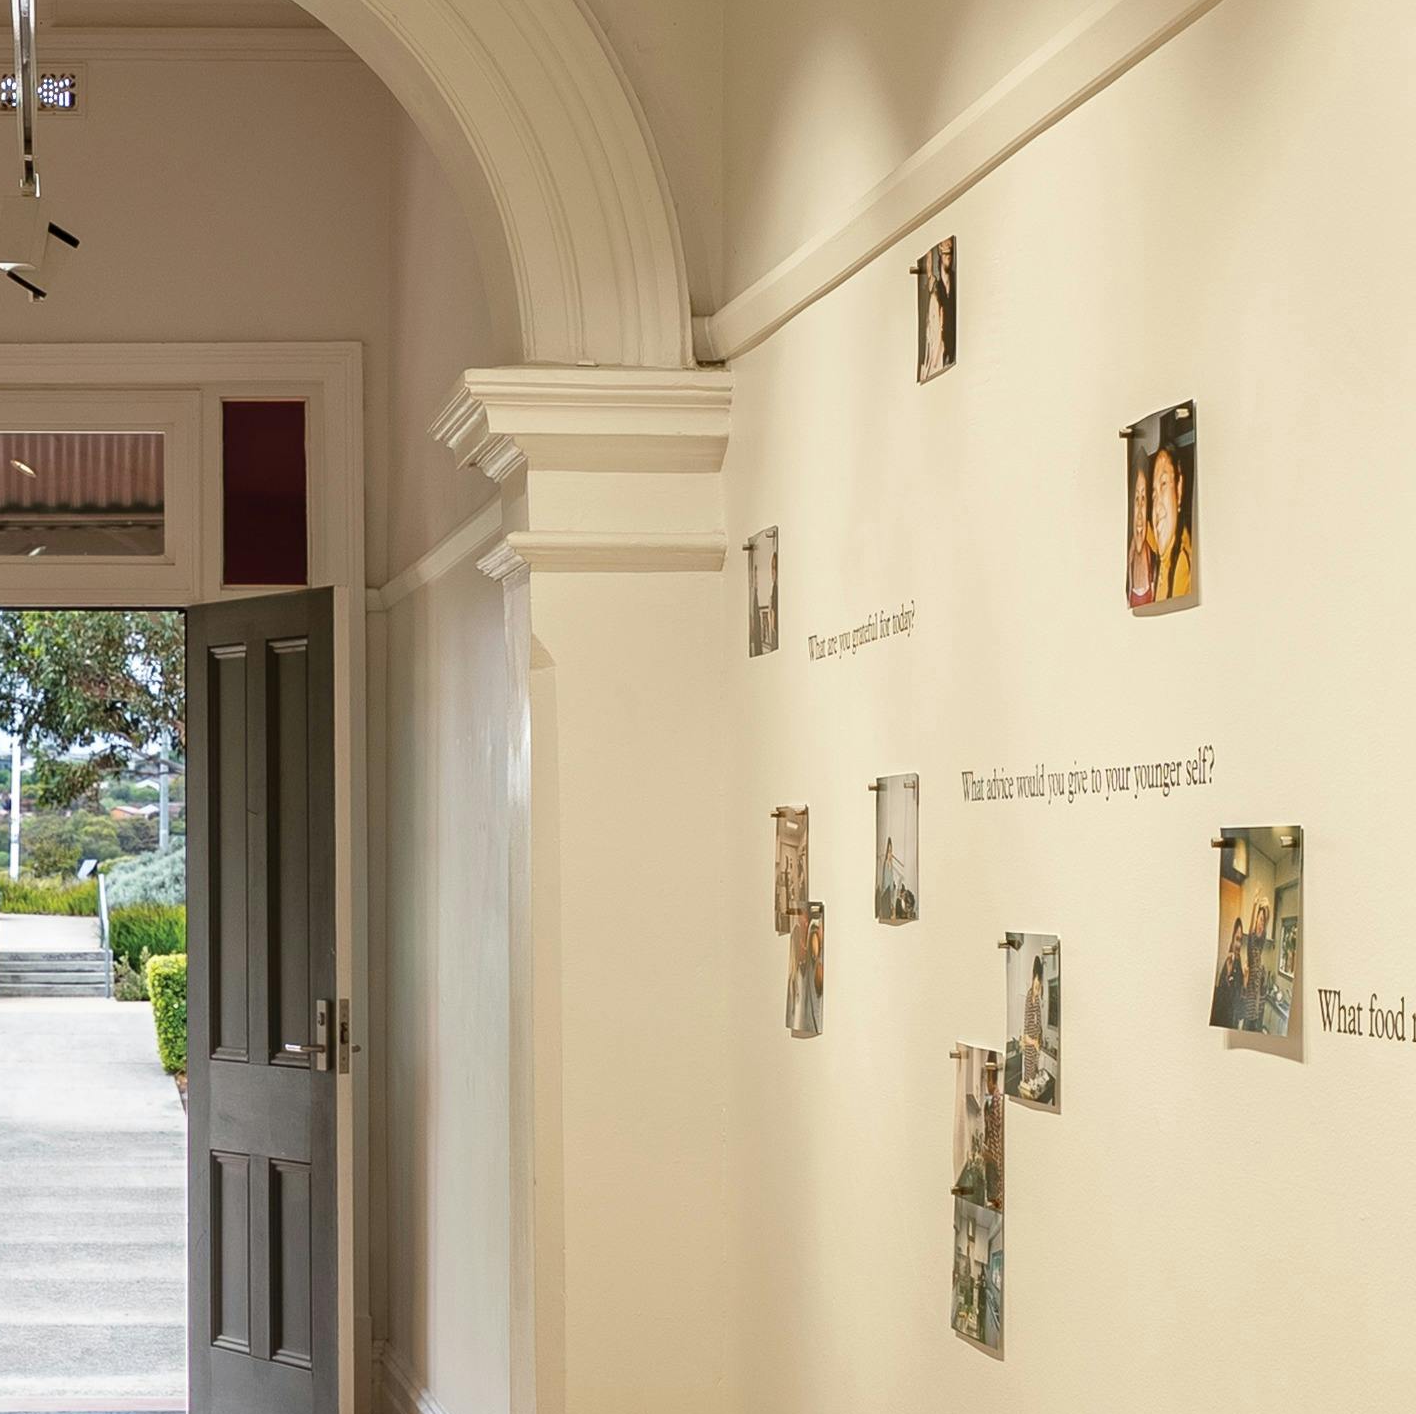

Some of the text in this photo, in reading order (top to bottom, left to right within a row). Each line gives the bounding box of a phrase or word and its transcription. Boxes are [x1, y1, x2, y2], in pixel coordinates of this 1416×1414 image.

[808, 635, 826, 661] What
[839, 632, 850, 659] you
[880, 610, 891, 639] for
[962, 744, 1215, 804] What advice would you give to your younger self?
[1317, 988, 1363, 1036] What
[1368, 992, 1406, 1042] food
